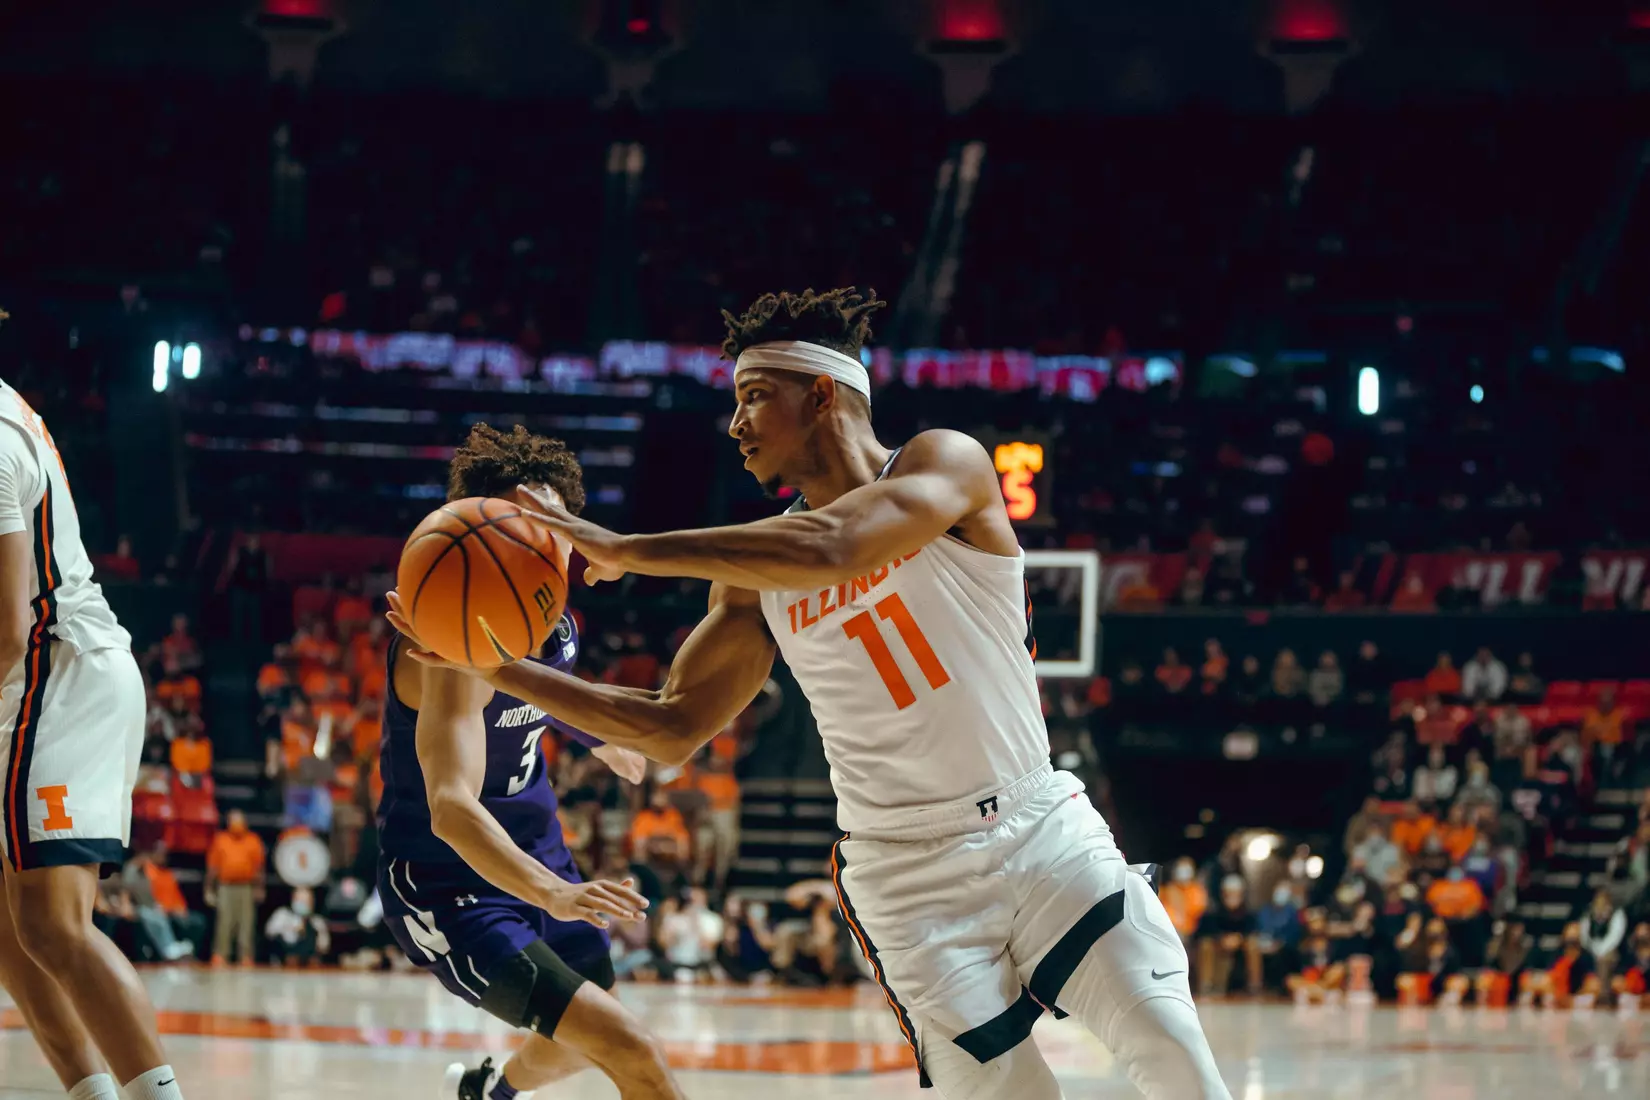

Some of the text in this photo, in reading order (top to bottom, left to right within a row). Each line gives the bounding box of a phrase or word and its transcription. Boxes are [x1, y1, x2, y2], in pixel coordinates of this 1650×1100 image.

[787, 548, 922, 635] ILLINO
[841, 592, 951, 711] 11
[506, 725, 547, 797] 3
[36, 785, 73, 832] I
[402, 910, 451, 962] N
